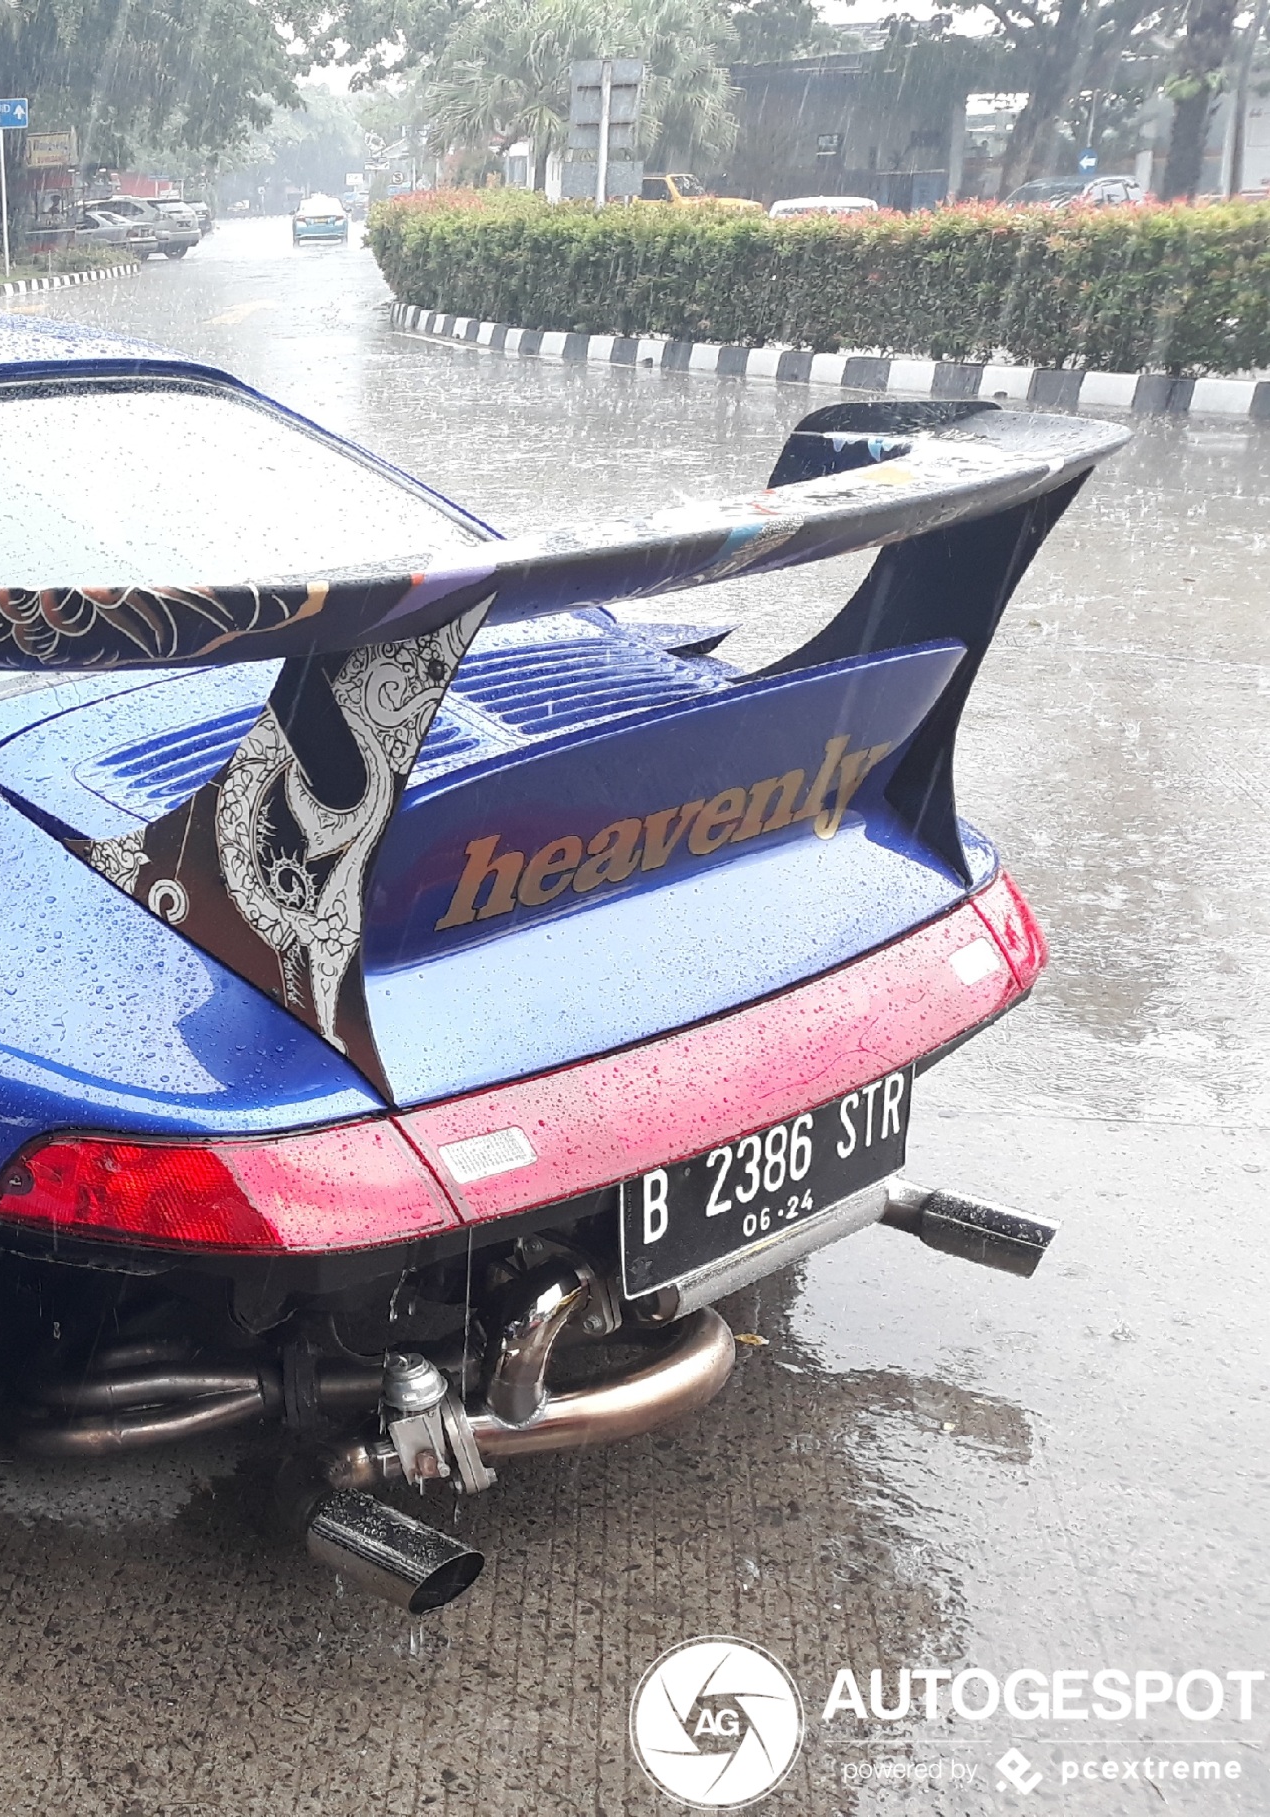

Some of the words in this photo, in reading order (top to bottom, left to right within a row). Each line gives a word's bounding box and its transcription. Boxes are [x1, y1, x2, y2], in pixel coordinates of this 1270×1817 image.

[434, 734, 892, 931] heavenly
[642, 1168, 669, 1245] B
[705, 1112, 814, 1218] 2386
[836, 1071, 906, 1159] STR
